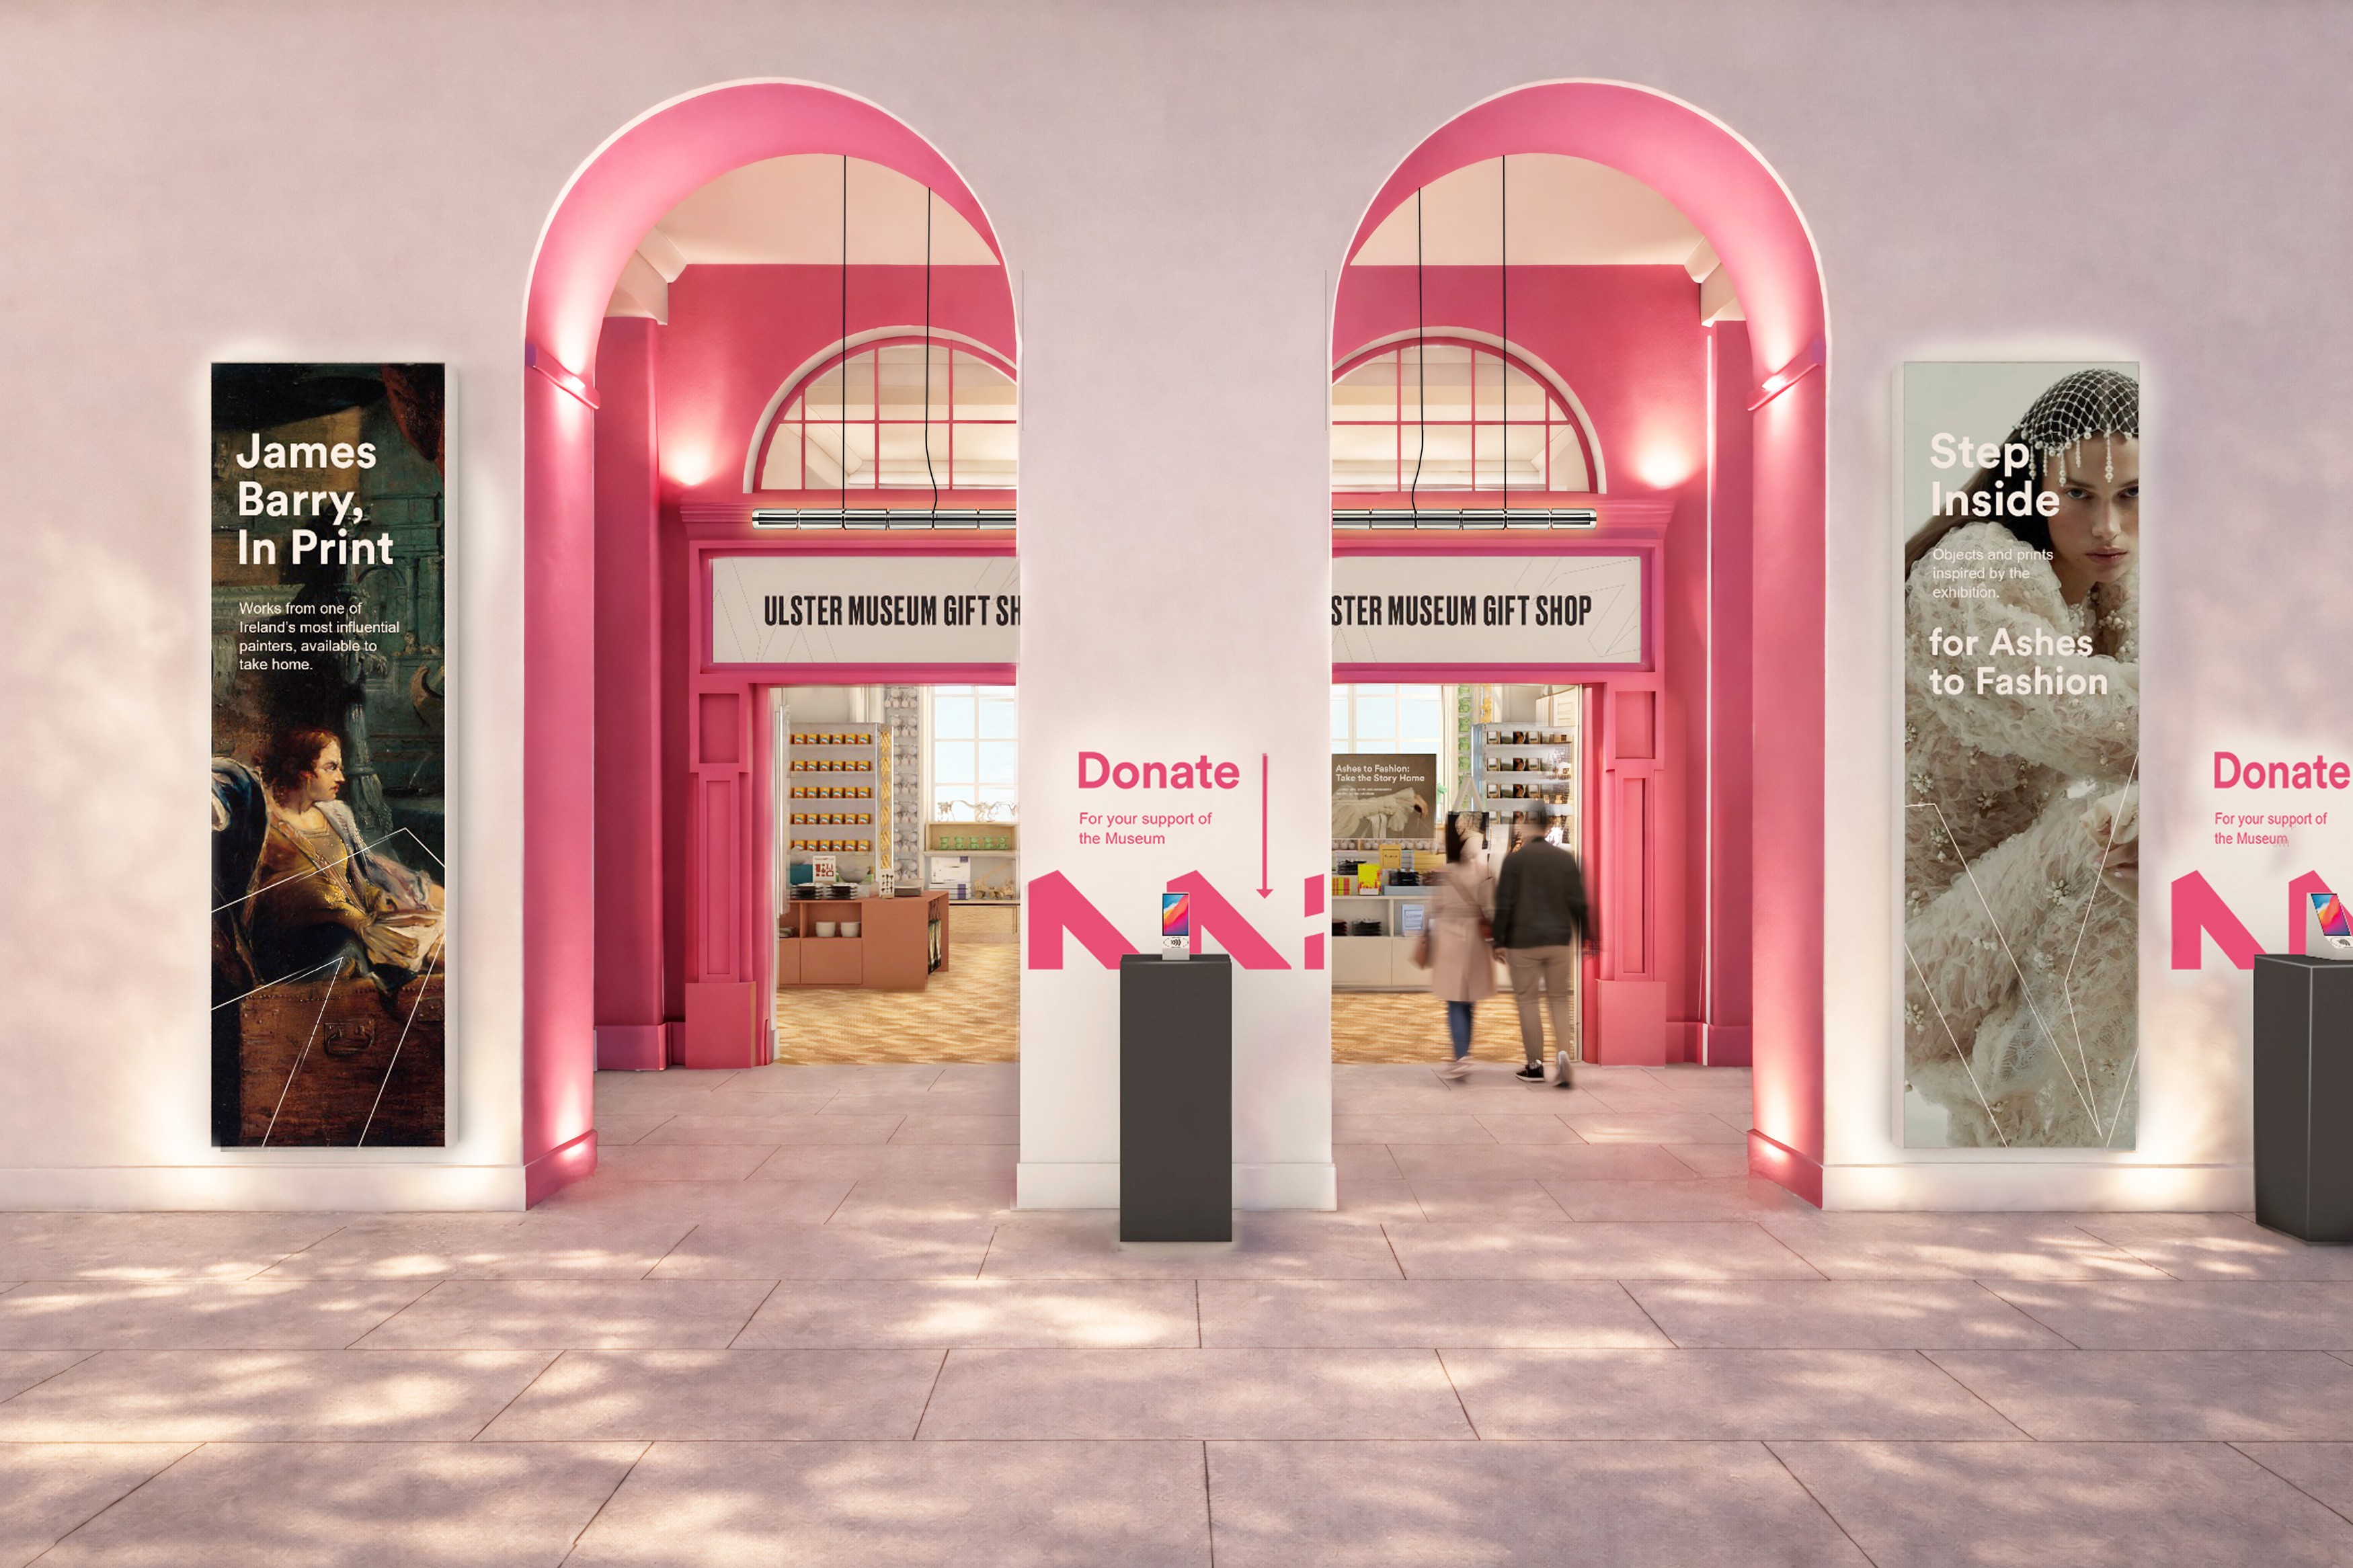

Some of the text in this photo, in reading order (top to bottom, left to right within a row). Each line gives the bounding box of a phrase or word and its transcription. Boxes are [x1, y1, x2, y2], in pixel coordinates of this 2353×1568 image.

[236, 433, 376, 469] James
[1930, 432, 2030, 477] Step
[239, 481, 364, 526] Barry,
[1932, 480, 2060, 517] Inside
[239, 528, 394, 565] In Print
[1933, 548, 2054, 563] Objects and prints
[1933, 567, 2030, 582] inspired by the
[1933, 587, 2000, 598] exhibition.
[239, 602, 363, 614] Works from one of
[764, 595, 1021, 626] ULSTER MUSEUM GIFT SH
[1331, 595, 1592, 626] STER MUSEUM GIFT SHOP
[240, 620, 400, 633] Ireland's most influential
[239, 639, 377, 655] painters, available to
[1929, 627, 2093, 657] for Ashes
[239, 658, 313, 670] take home.
[1929, 666, 2108, 695] to Fashion
[1078, 751, 1240, 790] Donate
[2214, 751, 2351, 790] Donate
[1373, 774, 1398, 784] Story
[1079, 812, 1213, 827] For your support of
[2215, 812, 2328, 828] For your support of
[1079, 832, 1165, 845] the Museum
[2215, 832, 2288, 845] the Museum
